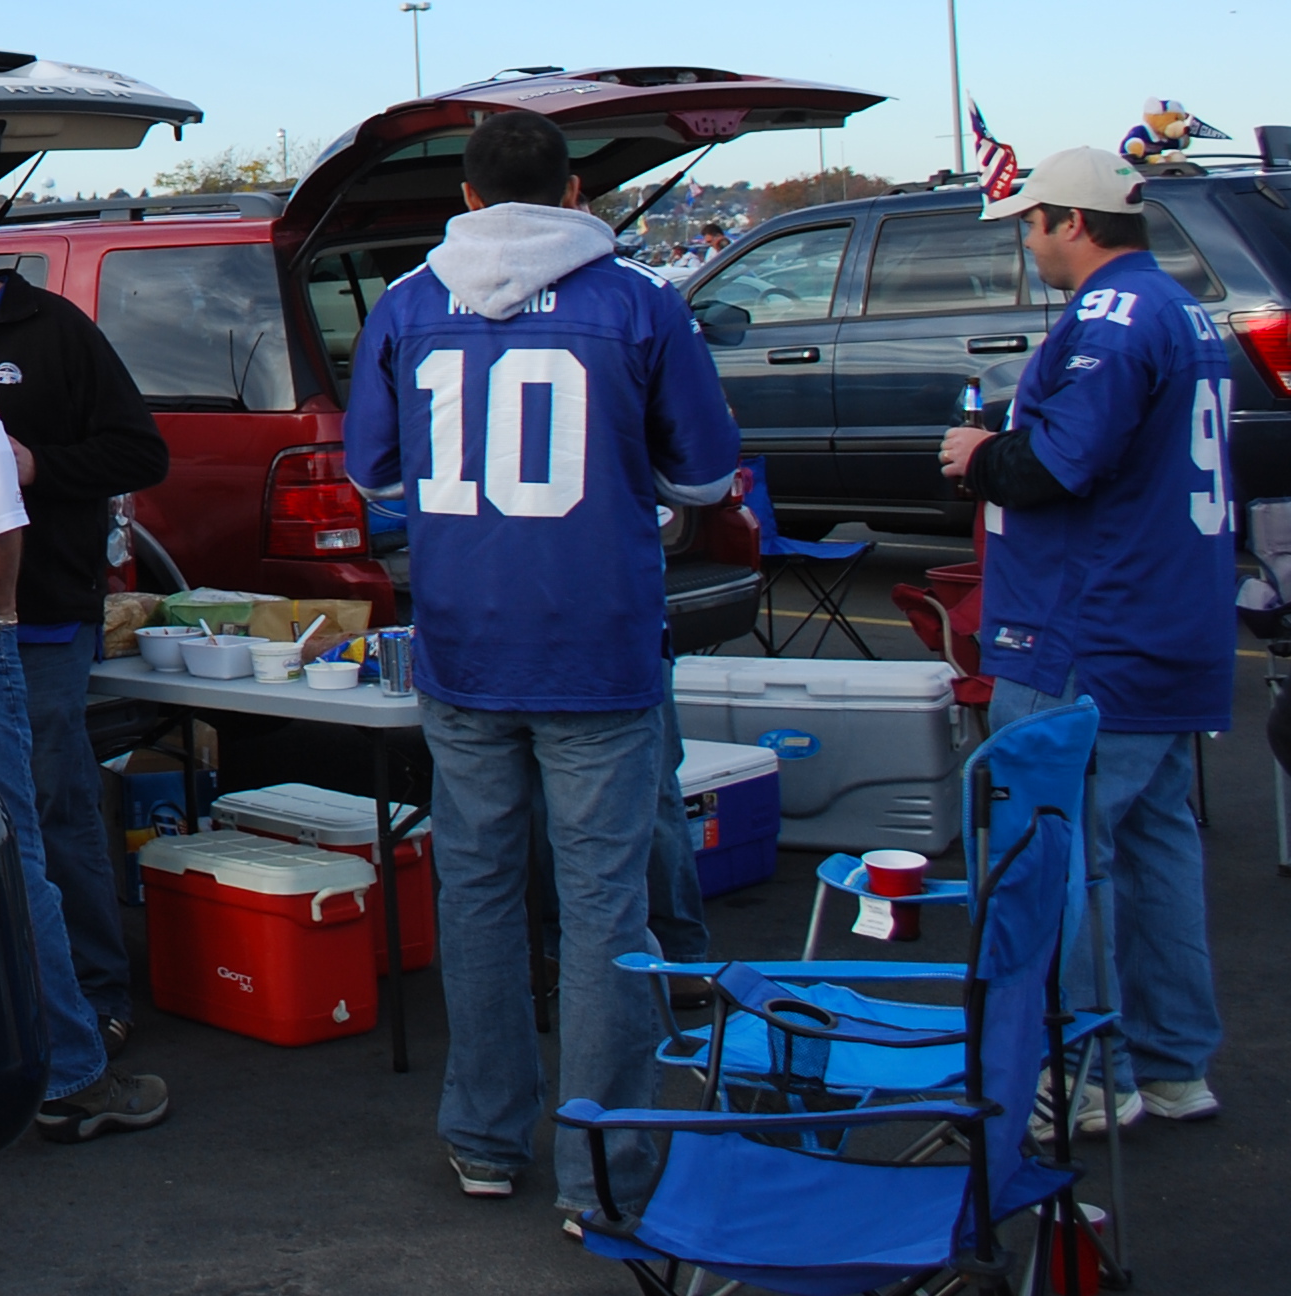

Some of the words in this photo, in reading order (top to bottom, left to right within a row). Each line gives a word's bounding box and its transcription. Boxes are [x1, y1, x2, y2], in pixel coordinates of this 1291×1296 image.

[3, 84, 132, 99] ROVER
[1077, 288, 1137, 326] 91
[415, 348, 587, 517] 10
